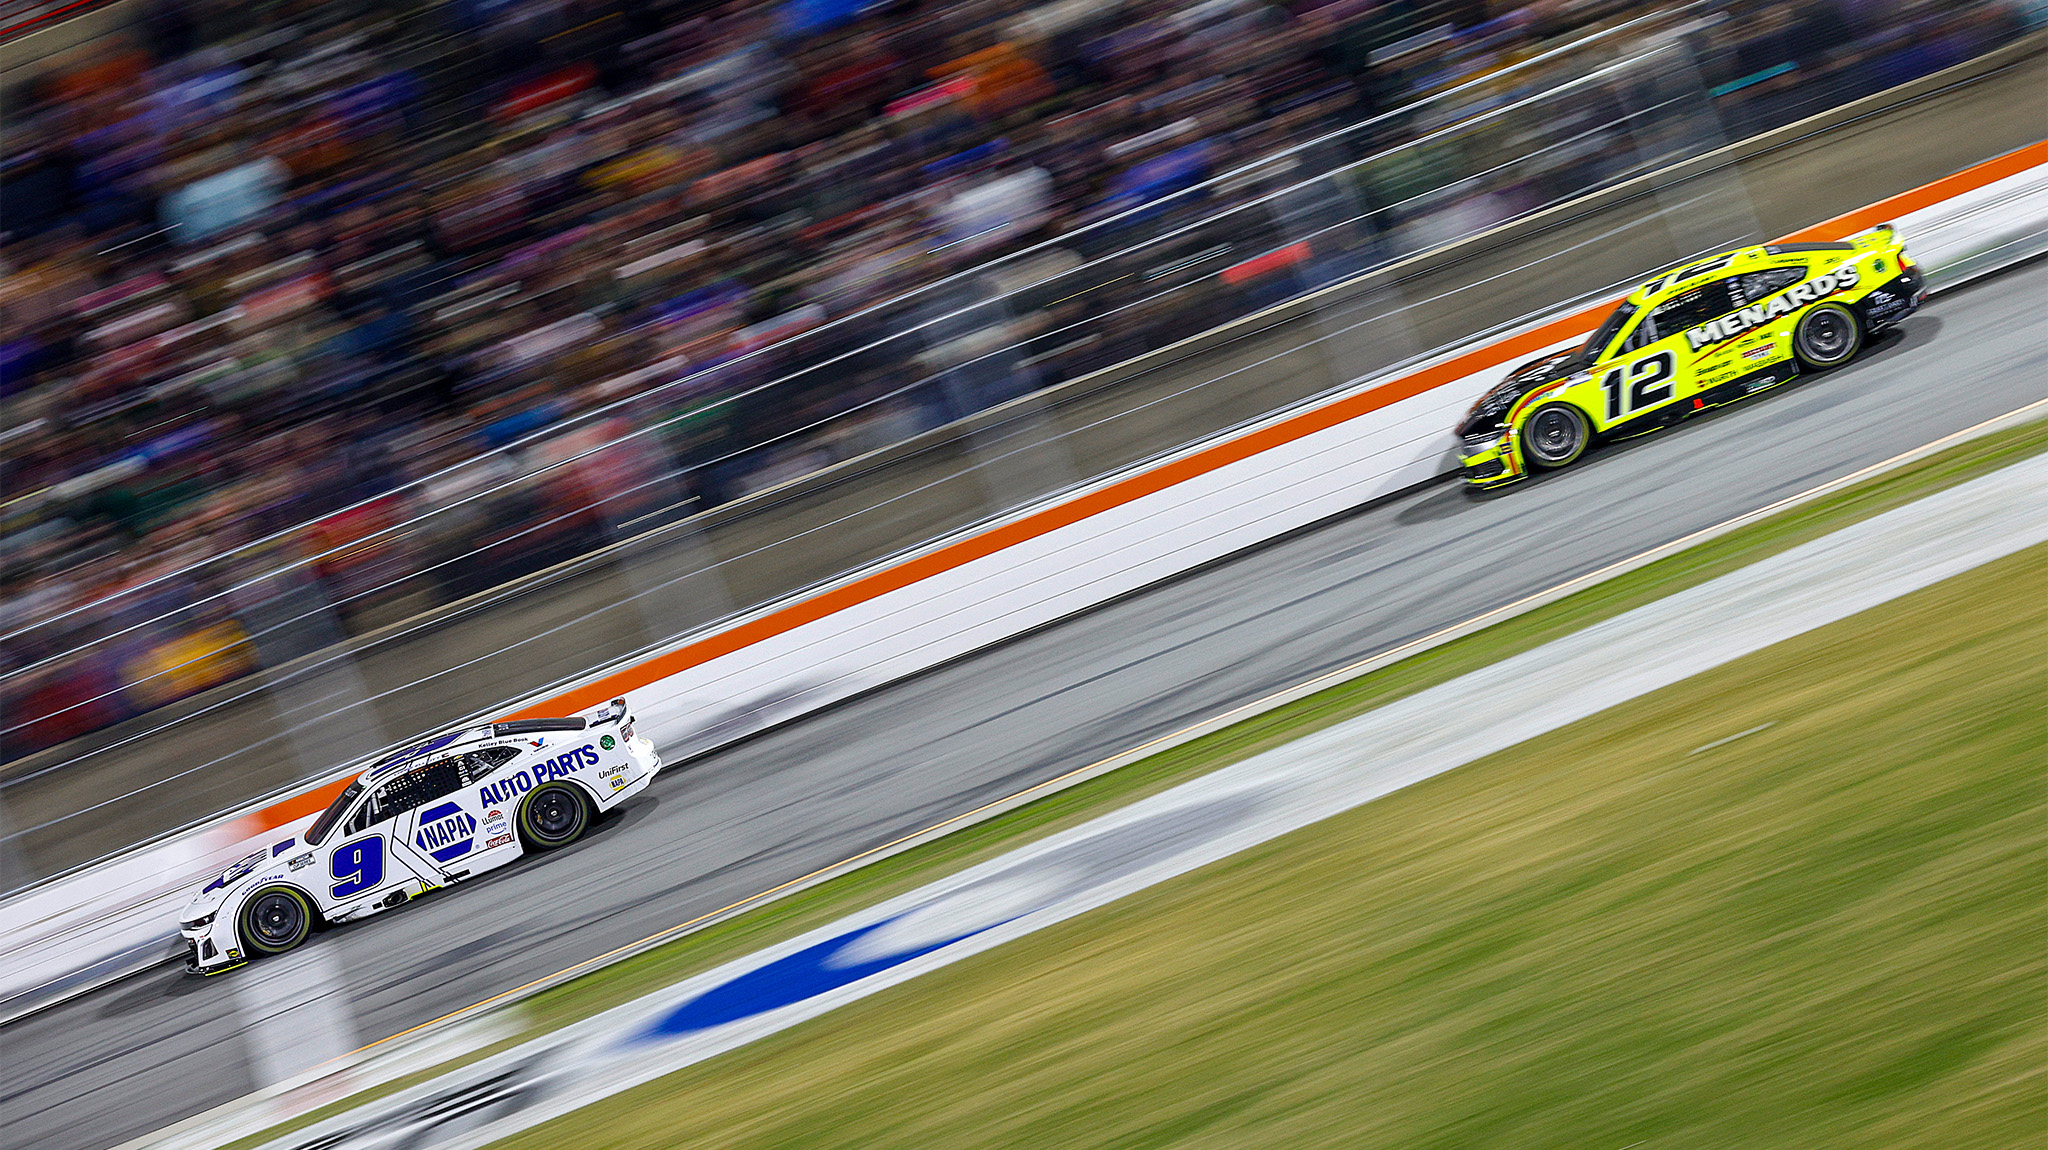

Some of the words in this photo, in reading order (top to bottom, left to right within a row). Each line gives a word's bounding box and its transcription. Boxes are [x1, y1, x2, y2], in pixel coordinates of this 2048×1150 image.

[1684, 263, 1861, 352] MENARDS
[1599, 349, 1677, 423] 12
[478, 741, 497, 749] Kelley
[498, 738, 513, 746] Blue
[513, 736, 528, 744] Book
[479, 770, 532, 809] AUTO
[531, 744, 599, 785] PARTS
[598, 762, 629, 779] UniFirst
[610, 778, 625, 788] NAPA
[422, 814, 470, 850] NAPA
[486, 821, 508, 833] prime
[330, 834, 385, 899] 9
[241, 874, 284, 895] GOODYEAR
